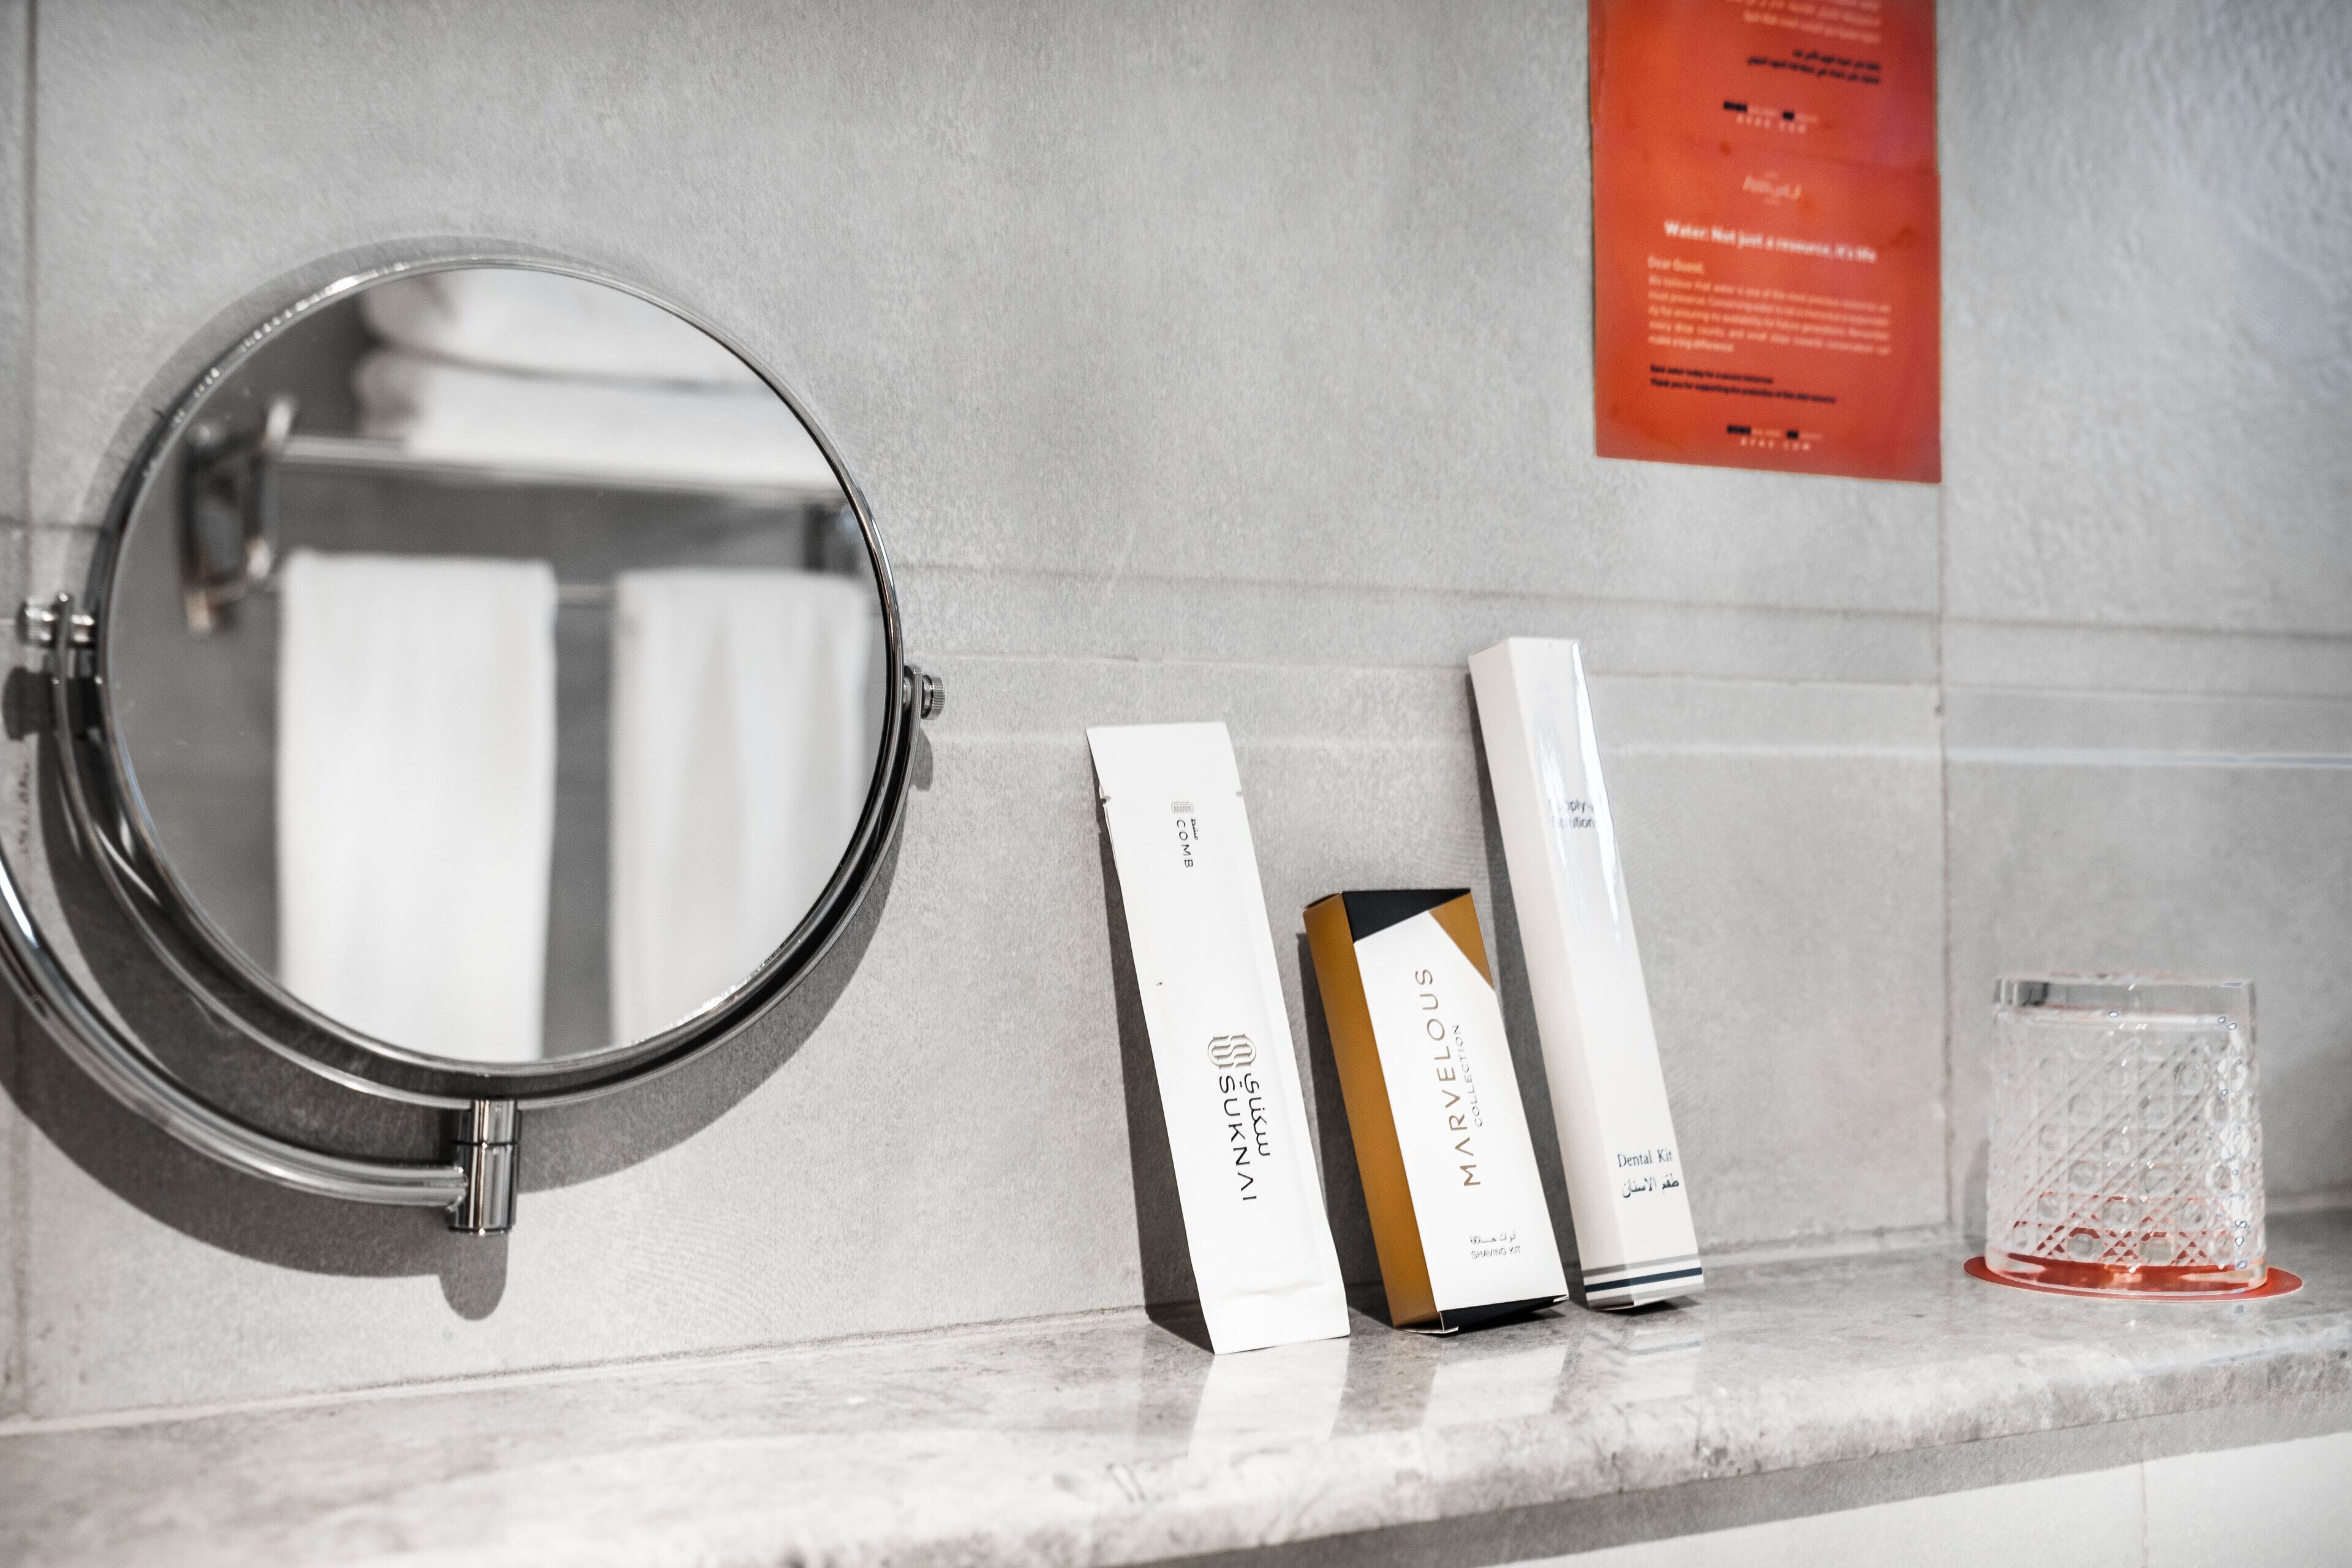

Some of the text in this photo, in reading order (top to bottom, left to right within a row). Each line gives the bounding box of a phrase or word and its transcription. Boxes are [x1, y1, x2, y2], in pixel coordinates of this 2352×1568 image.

[1711, 227, 1735, 244] Not
[1738, 230, 1763, 249] just
[1766, 237, 1774, 249] a
[1177, 820, 1193, 867] COMB
[1415, 969, 1480, 1186] MARVELOUS
[1452, 1024, 1482, 1127] COLLECTION
[1219, 1076, 1257, 1200] SUKNAI
[1618, 1149, 1673, 1167] Dental Kit
[1662, 1173, 1679, 1196] طقم
[1471, 1246, 1520, 1259] SHAVING KIT
